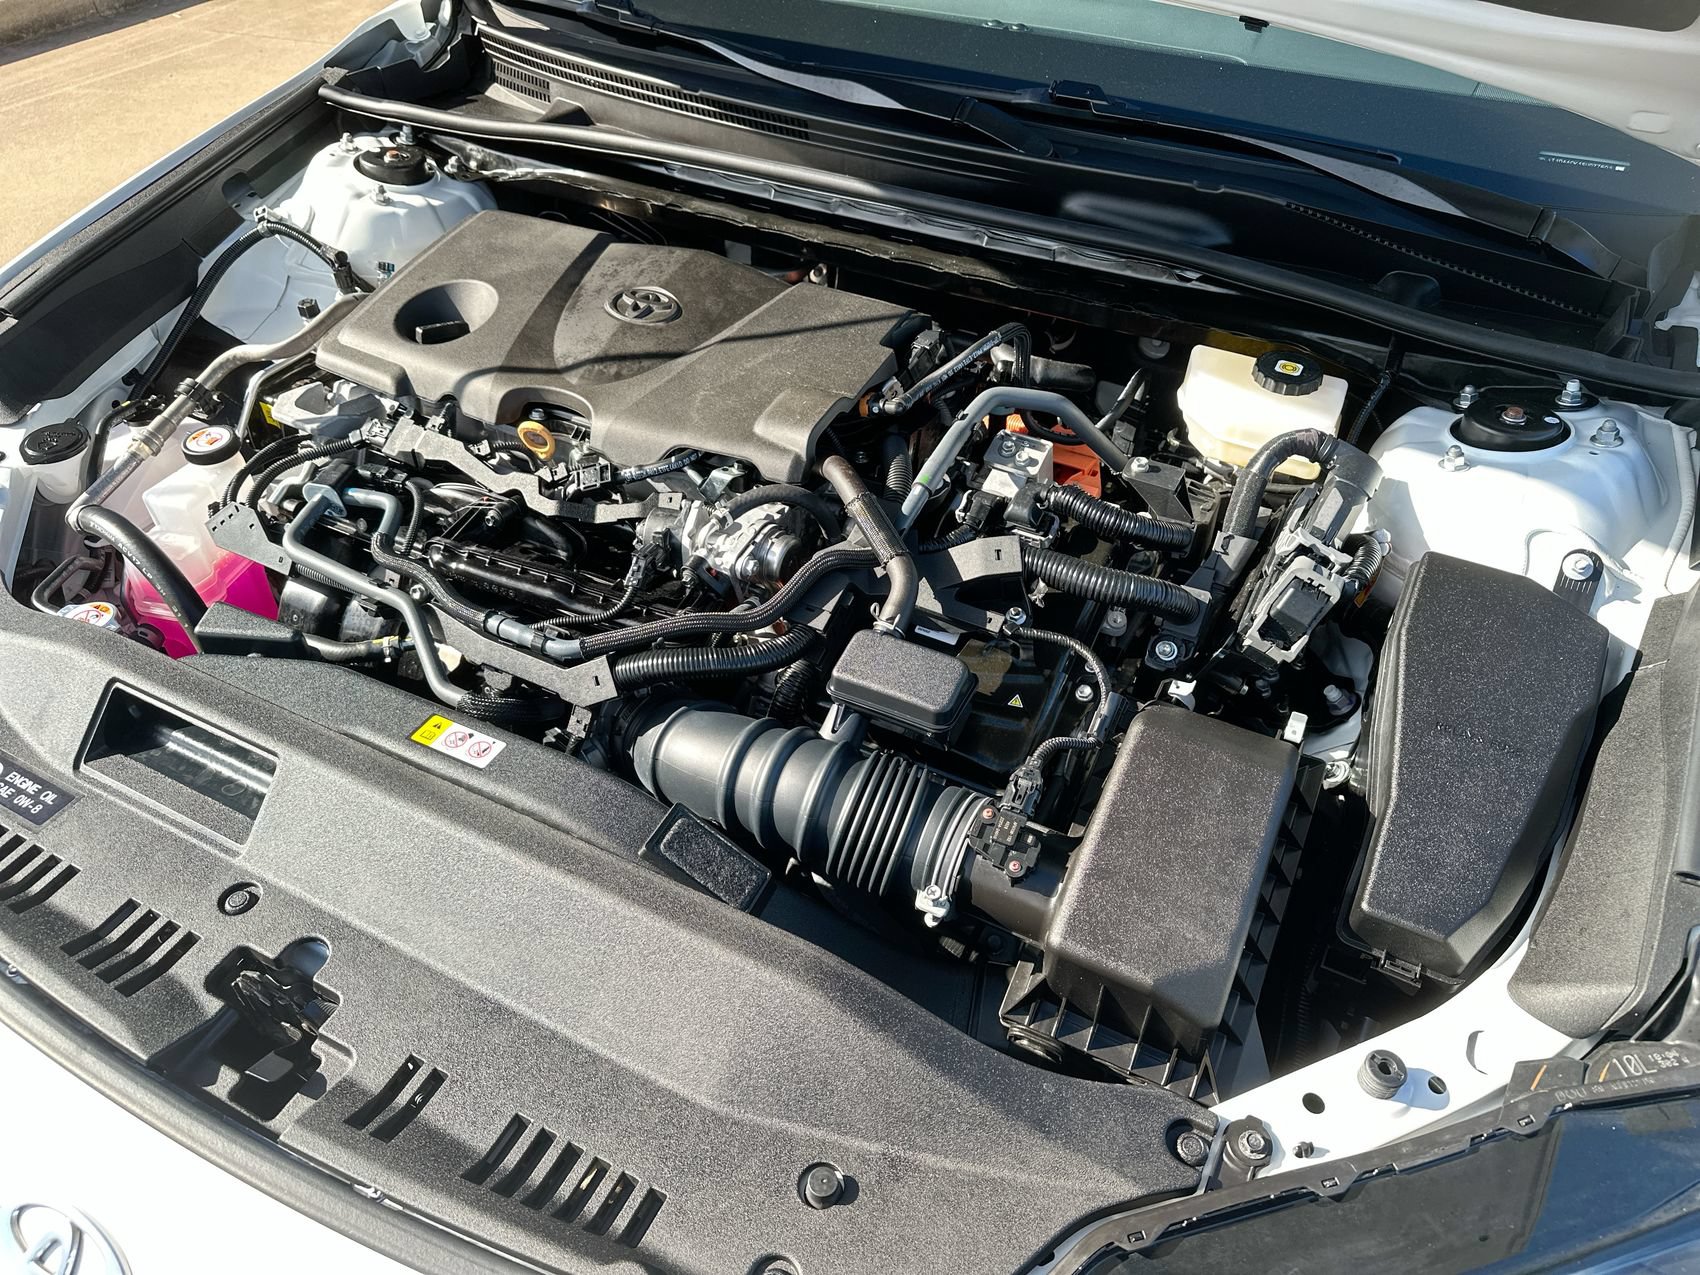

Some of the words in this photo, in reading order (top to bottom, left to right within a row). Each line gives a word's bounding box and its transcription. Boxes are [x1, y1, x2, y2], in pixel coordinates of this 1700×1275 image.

[5, 772, 42, 794] ENGINE
[40, 791, 57, 804] OIL
[14, 795, 43, 814] 0W-8
